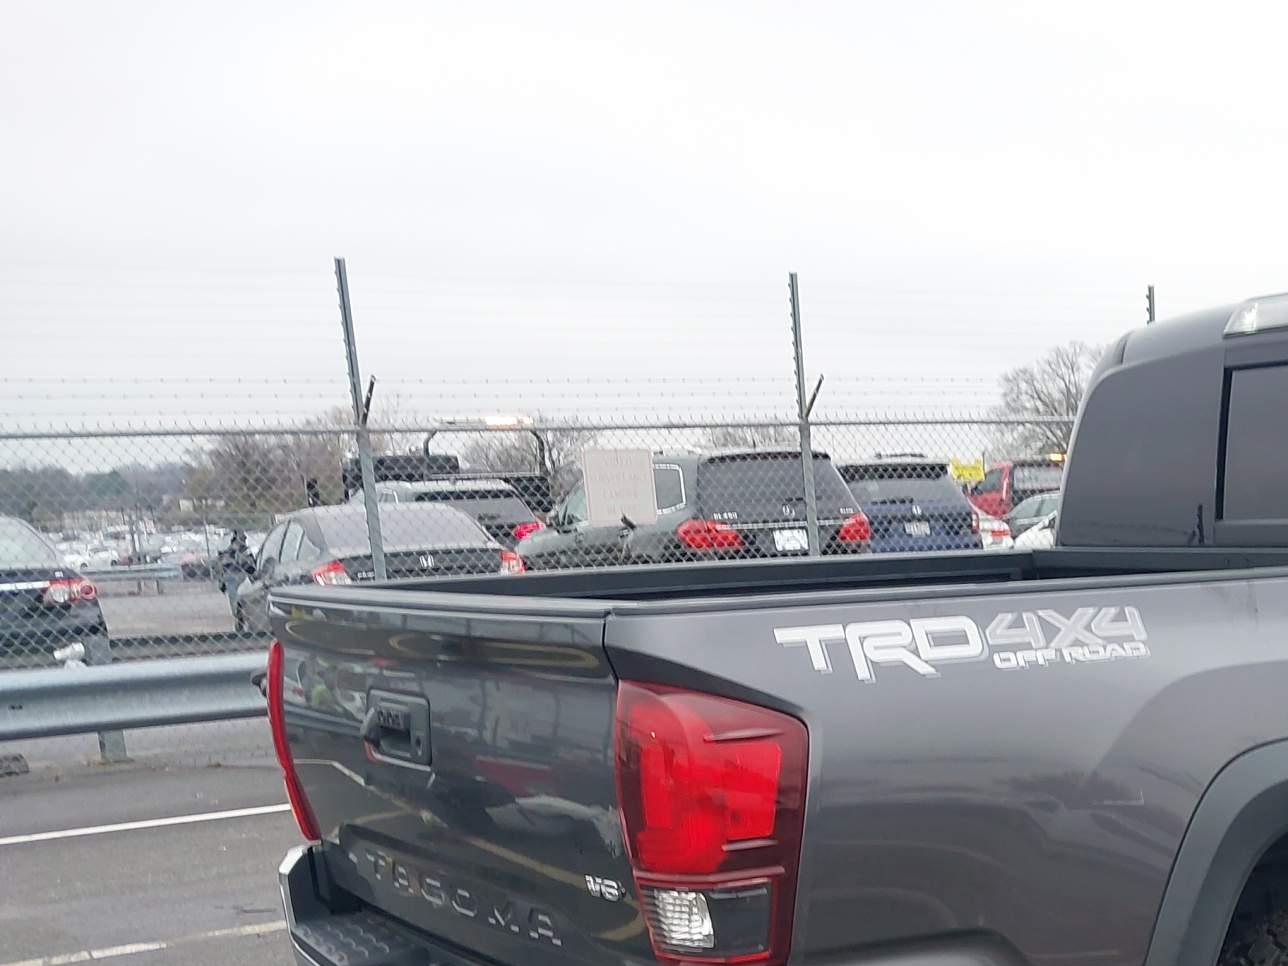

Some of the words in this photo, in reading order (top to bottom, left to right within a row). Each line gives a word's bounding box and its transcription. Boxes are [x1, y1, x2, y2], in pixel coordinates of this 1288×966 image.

[773, 615, 988, 683] TRD
[992, 648, 1059, 671] OFF
[1061, 641, 1151, 664] ROAD
[366, 848, 563, 947] TACOMA
[585, 874, 623, 902] V6
